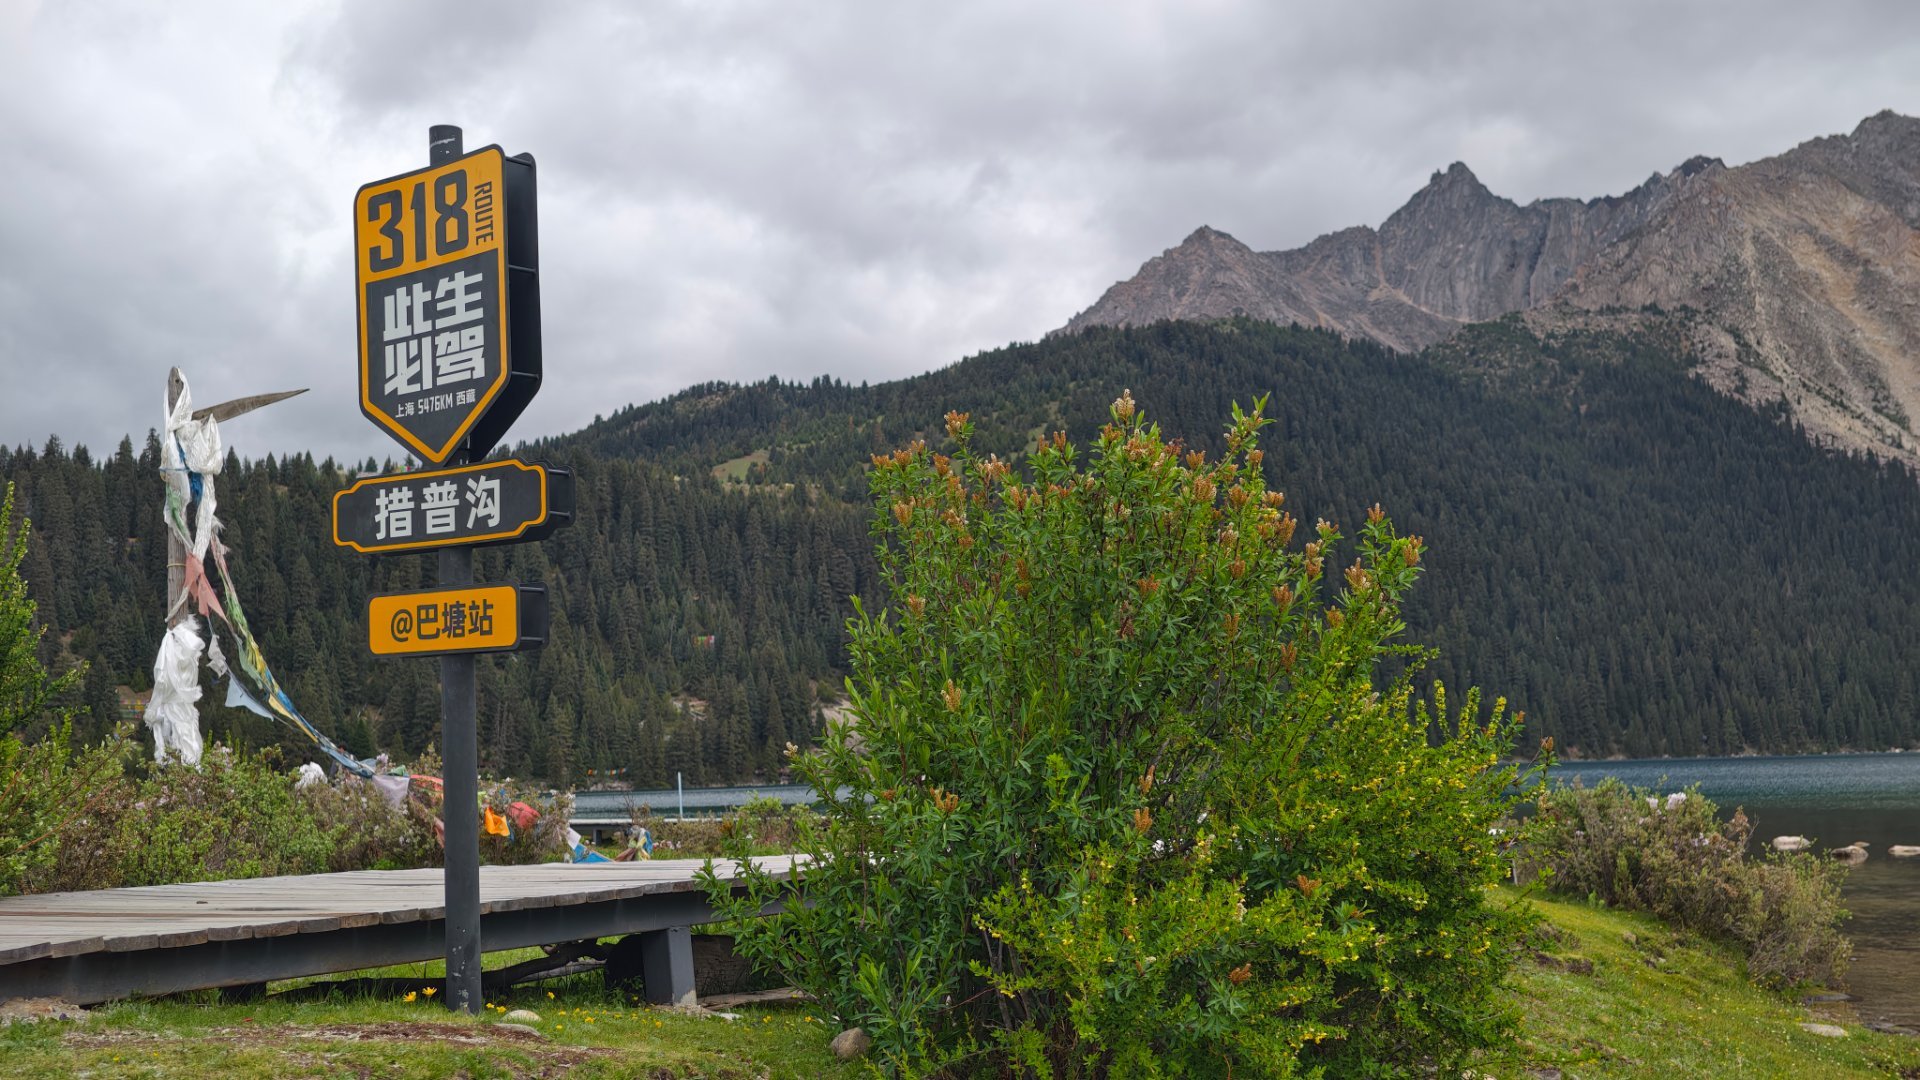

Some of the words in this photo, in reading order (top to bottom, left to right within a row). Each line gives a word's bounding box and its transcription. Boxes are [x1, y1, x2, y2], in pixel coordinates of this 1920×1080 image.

[368, 169, 469, 273] 318
[474, 181, 494, 246] ROUTE
[383, 271, 484, 342] 此生
[384, 324, 485, 396] 必驾
[395, 401, 415, 418] 上海
[418, 393, 453, 415] 5476KM
[456, 388, 476, 405] 西藏
[374, 475, 500, 540] 措普沟
[391, 599, 494, 642] @巴塘站
